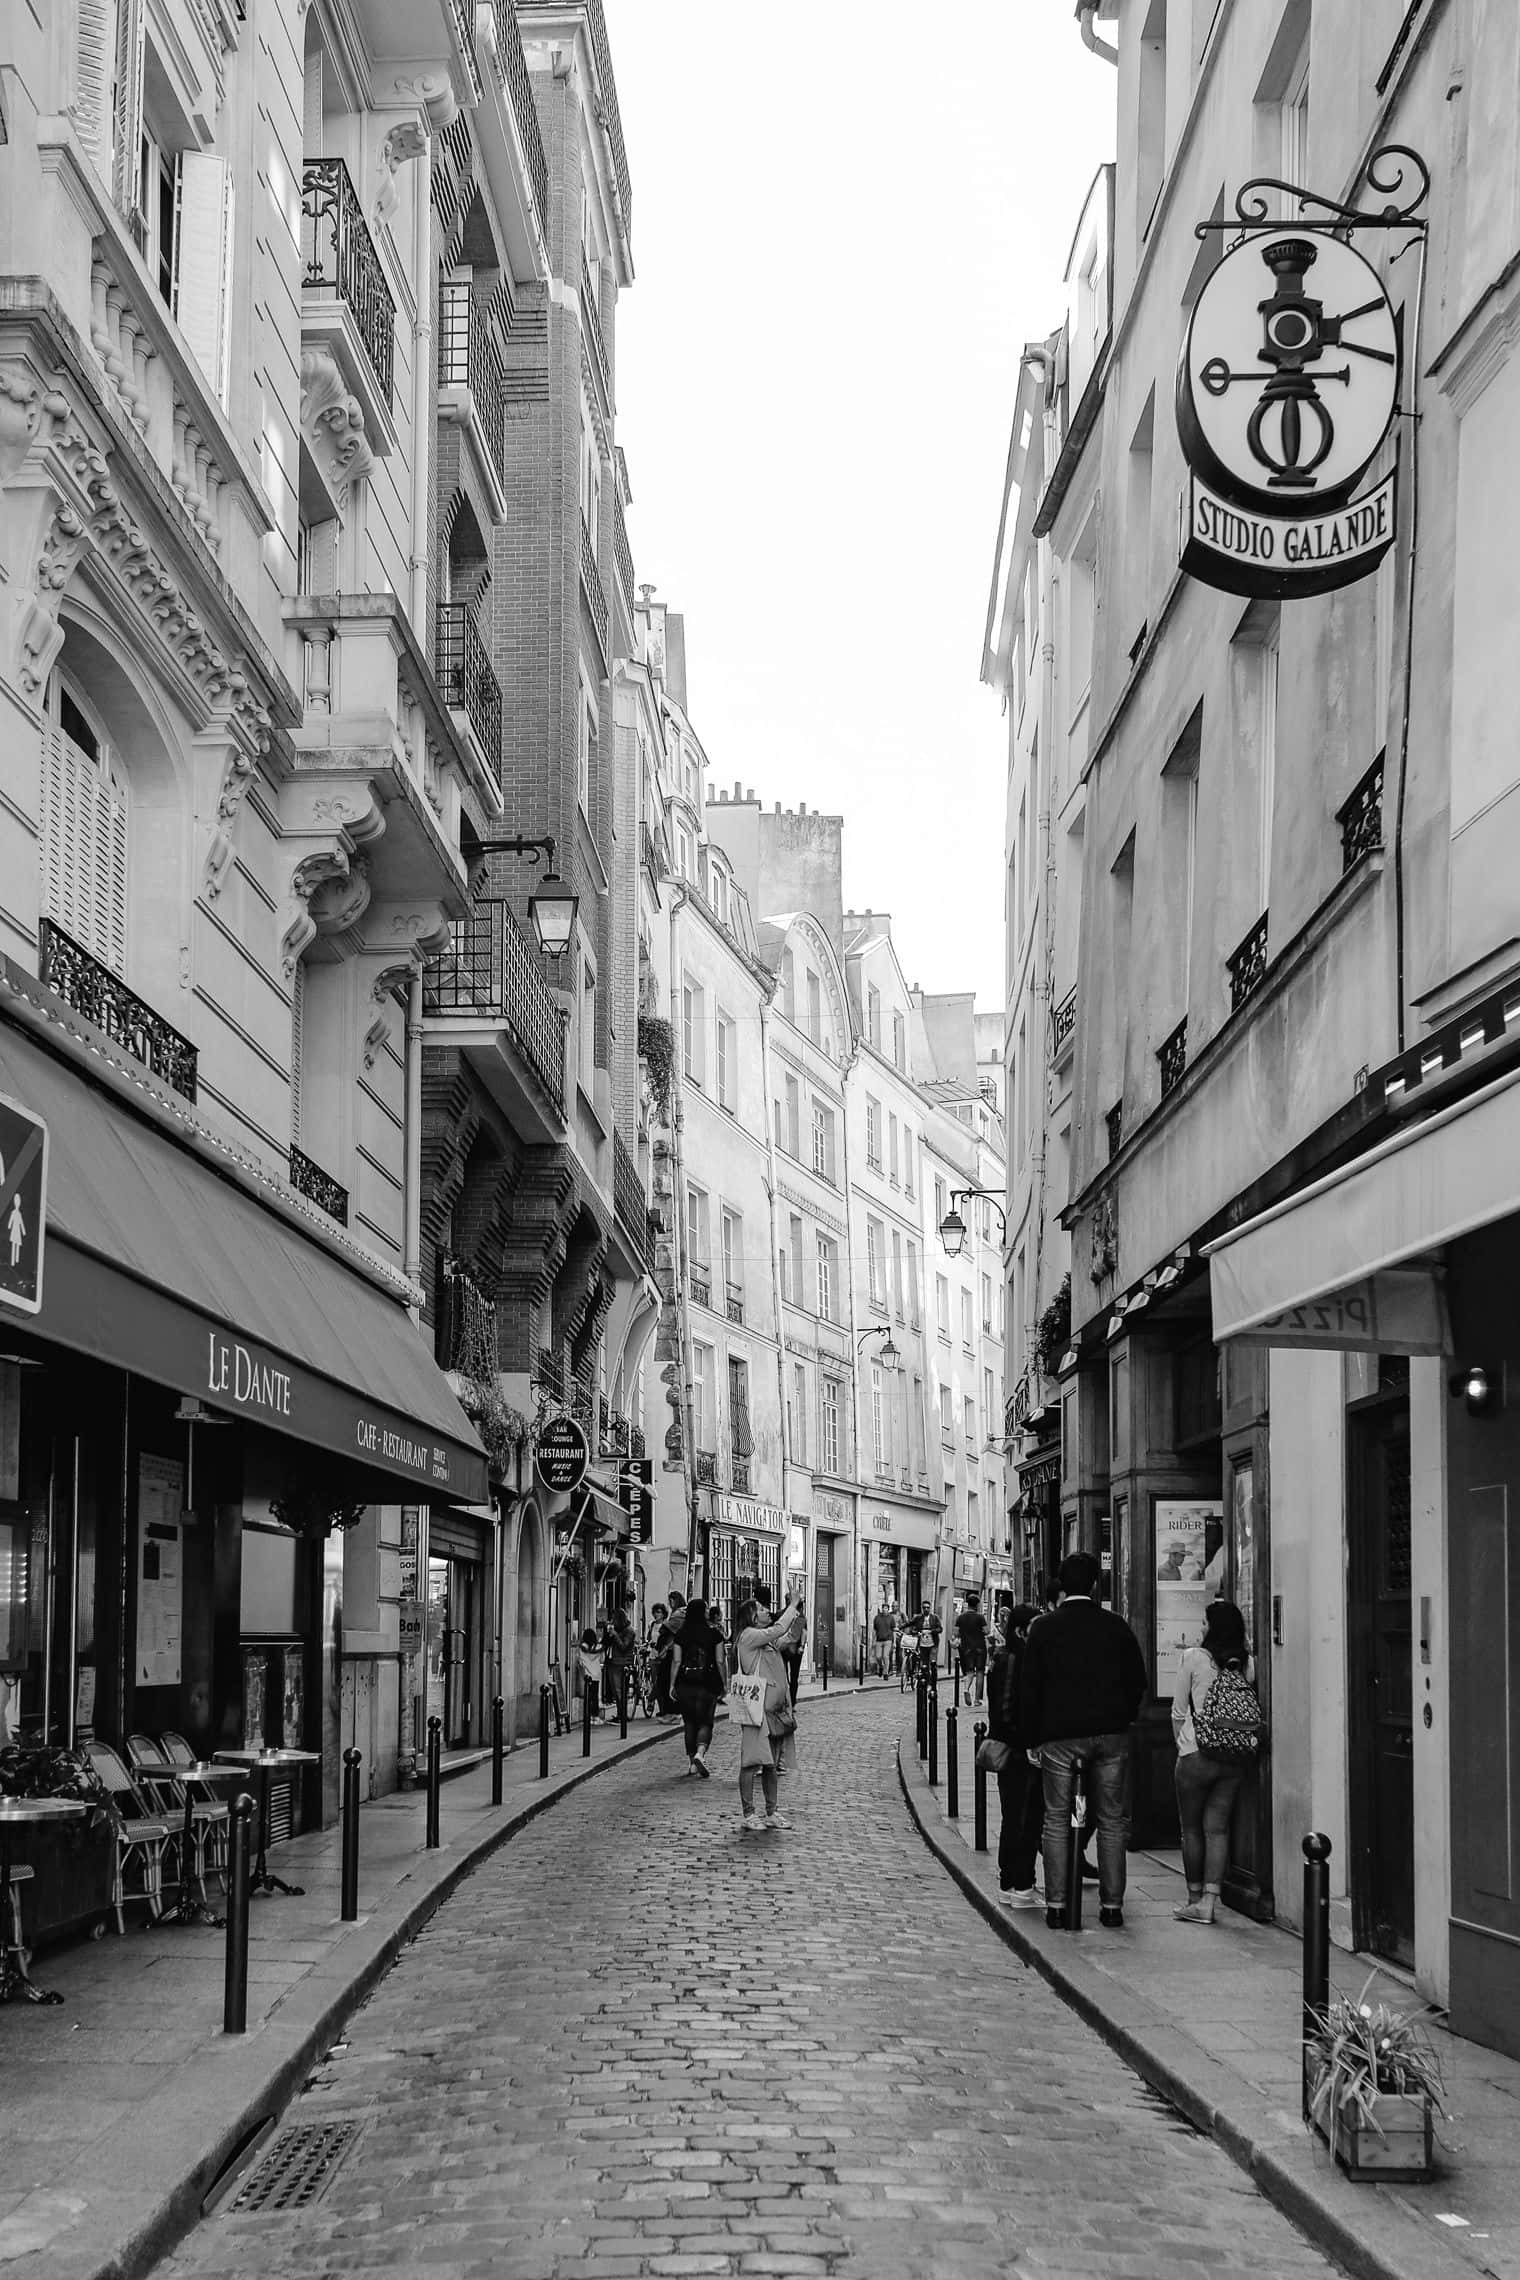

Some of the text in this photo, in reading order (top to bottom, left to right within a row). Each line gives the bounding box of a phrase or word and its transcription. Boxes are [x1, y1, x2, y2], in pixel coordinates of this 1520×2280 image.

[1197, 492, 1388, 562] STUDIO GALANDE
[208, 1332, 290, 1416] LE DANTE
[357, 1419, 377, 1451] CAFE
[382, 1429, 428, 1471] RESTAURANT
[539, 1448, 584, 1459] RESTAURANT
[629, 1462, 642, 1543] CÊPES
[721, 1499, 784, 1530] LE NAVIGATOR
[1168, 1520, 1202, 1531] RIDER
